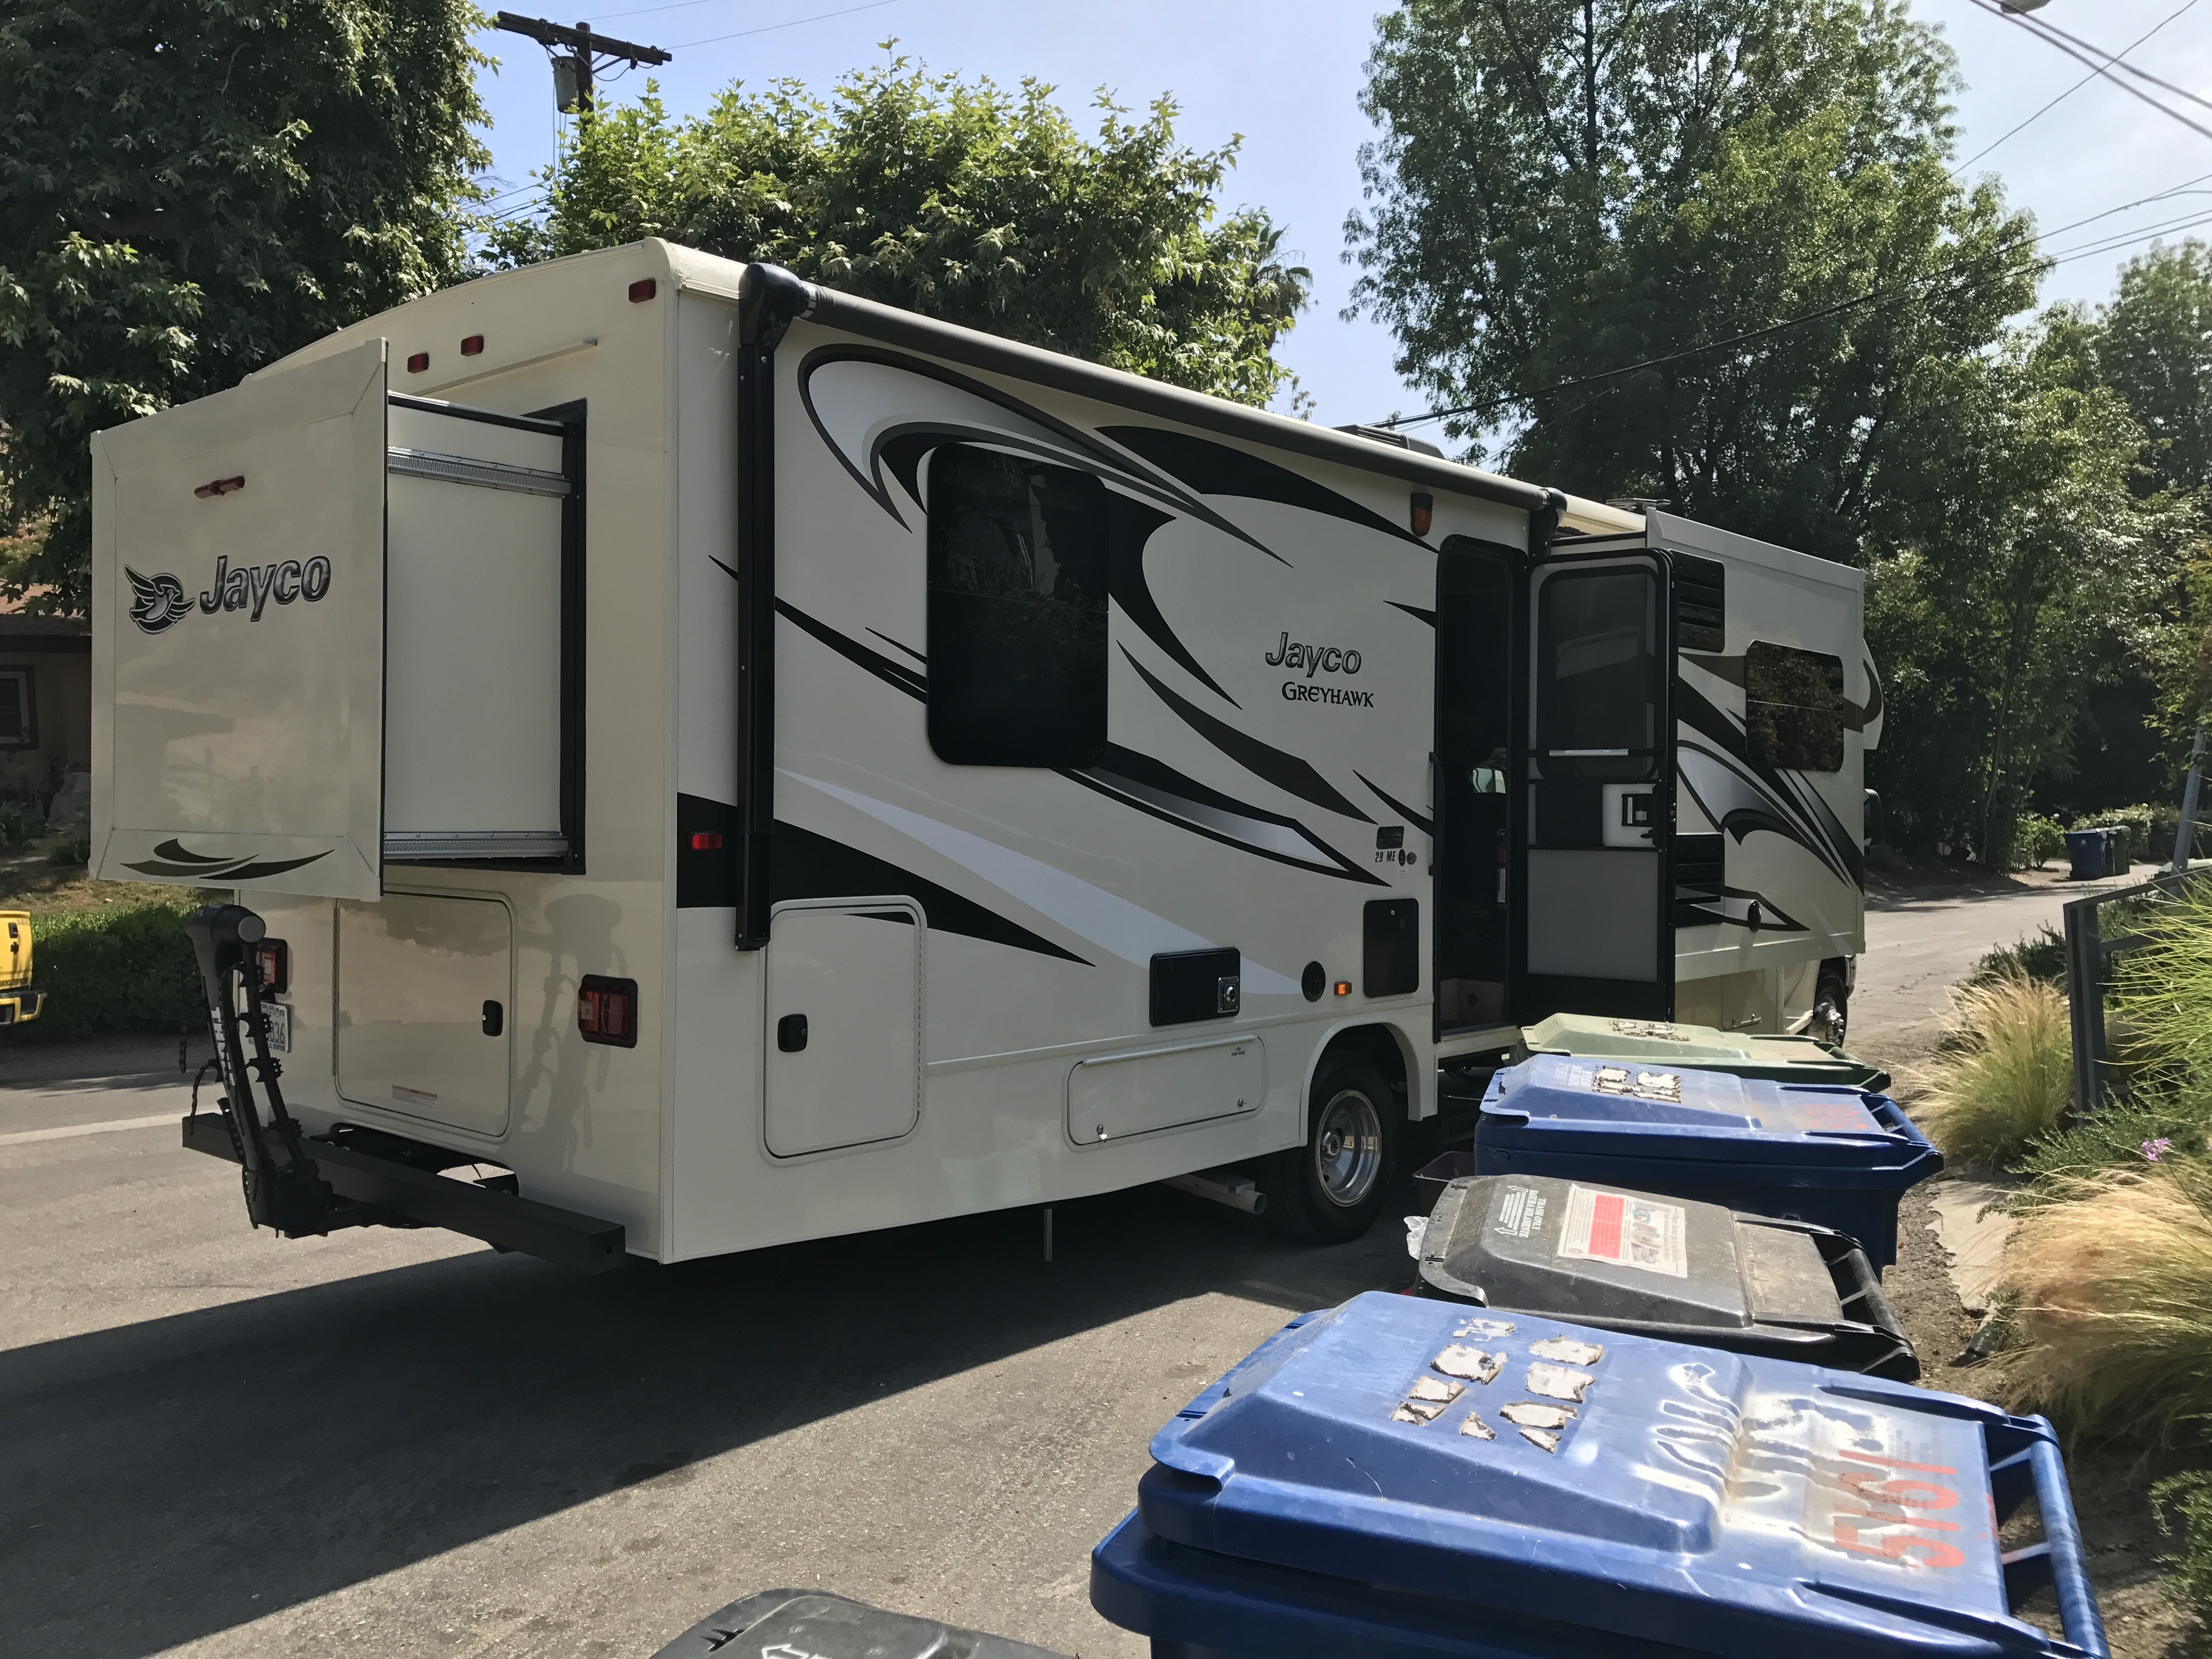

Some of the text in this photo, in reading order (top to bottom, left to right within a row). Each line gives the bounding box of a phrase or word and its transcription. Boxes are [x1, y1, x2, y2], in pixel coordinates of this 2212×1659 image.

[200, 555, 331, 622] Jayco
[1265, 631, 1362, 678] Jayco
[1282, 681, 1374, 708] GREYHAWK
[1375, 851, 1396, 862] 29 ME
[1519, 1189, 1539, 1238] BASURA SOLAMENTE
[1531, 1198, 1547, 1231] TRASH ONLY
[1833, 1449, 1966, 1568] 5161
